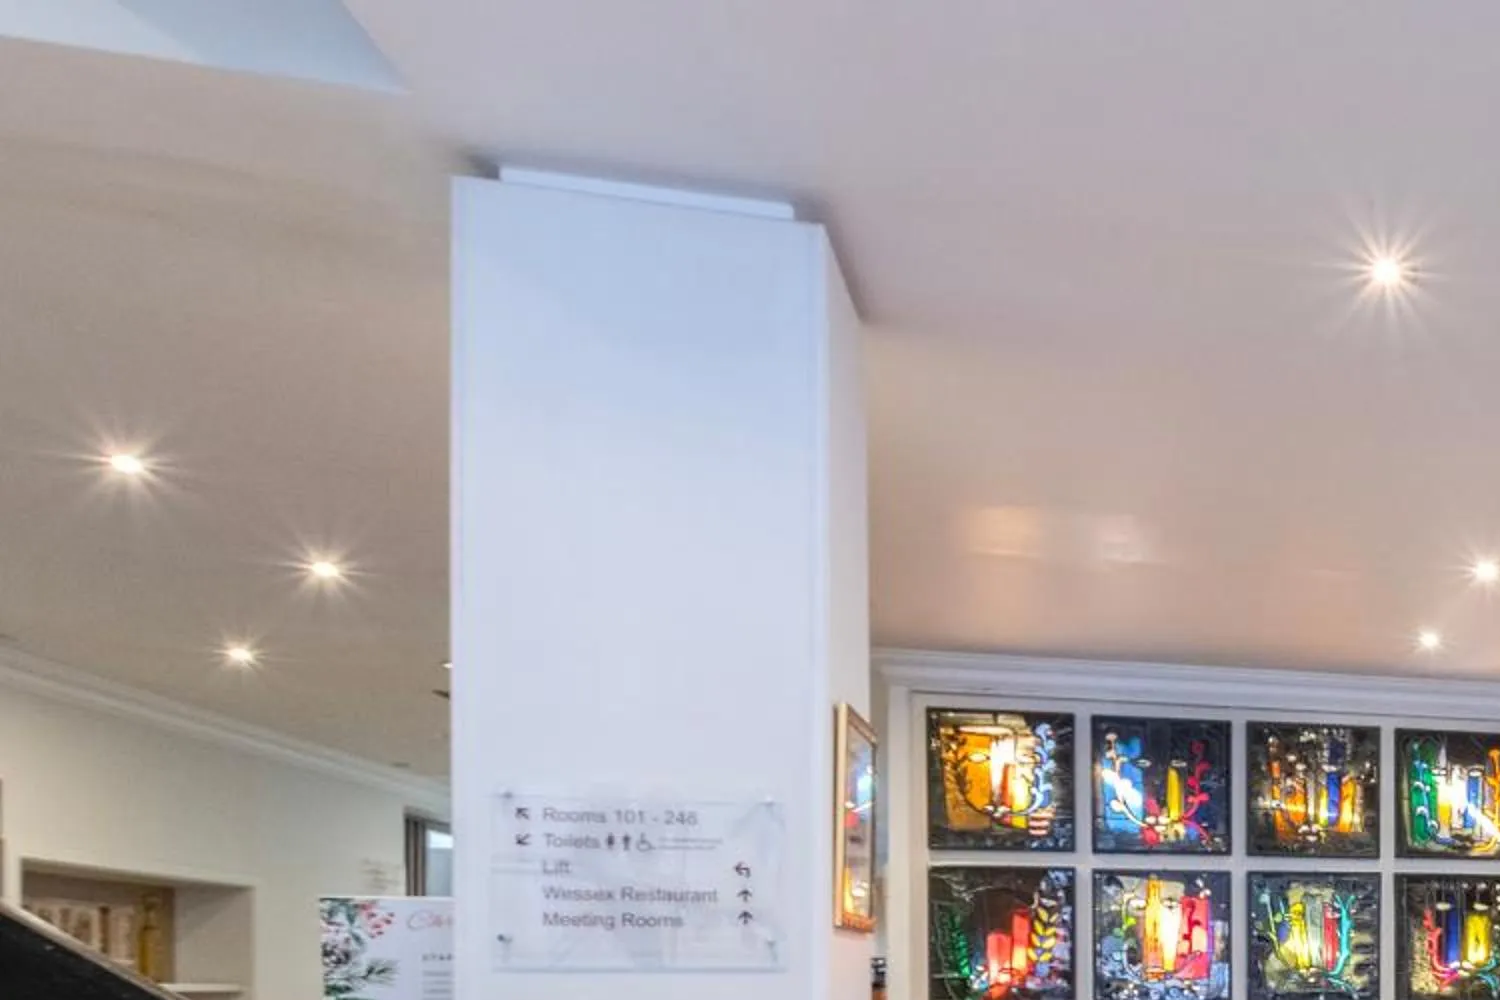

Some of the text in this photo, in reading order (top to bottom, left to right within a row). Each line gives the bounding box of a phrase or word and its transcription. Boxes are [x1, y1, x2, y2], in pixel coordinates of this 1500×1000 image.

[542, 807, 608, 824] Rooms
[614, 809, 646, 825] 101
[543, 832, 601, 849] Toilets
[542, 860, 572, 875] Lift
[542, 886, 719, 903] Wessex Restaurant
[542, 911, 684, 930] Meeting Rooms
